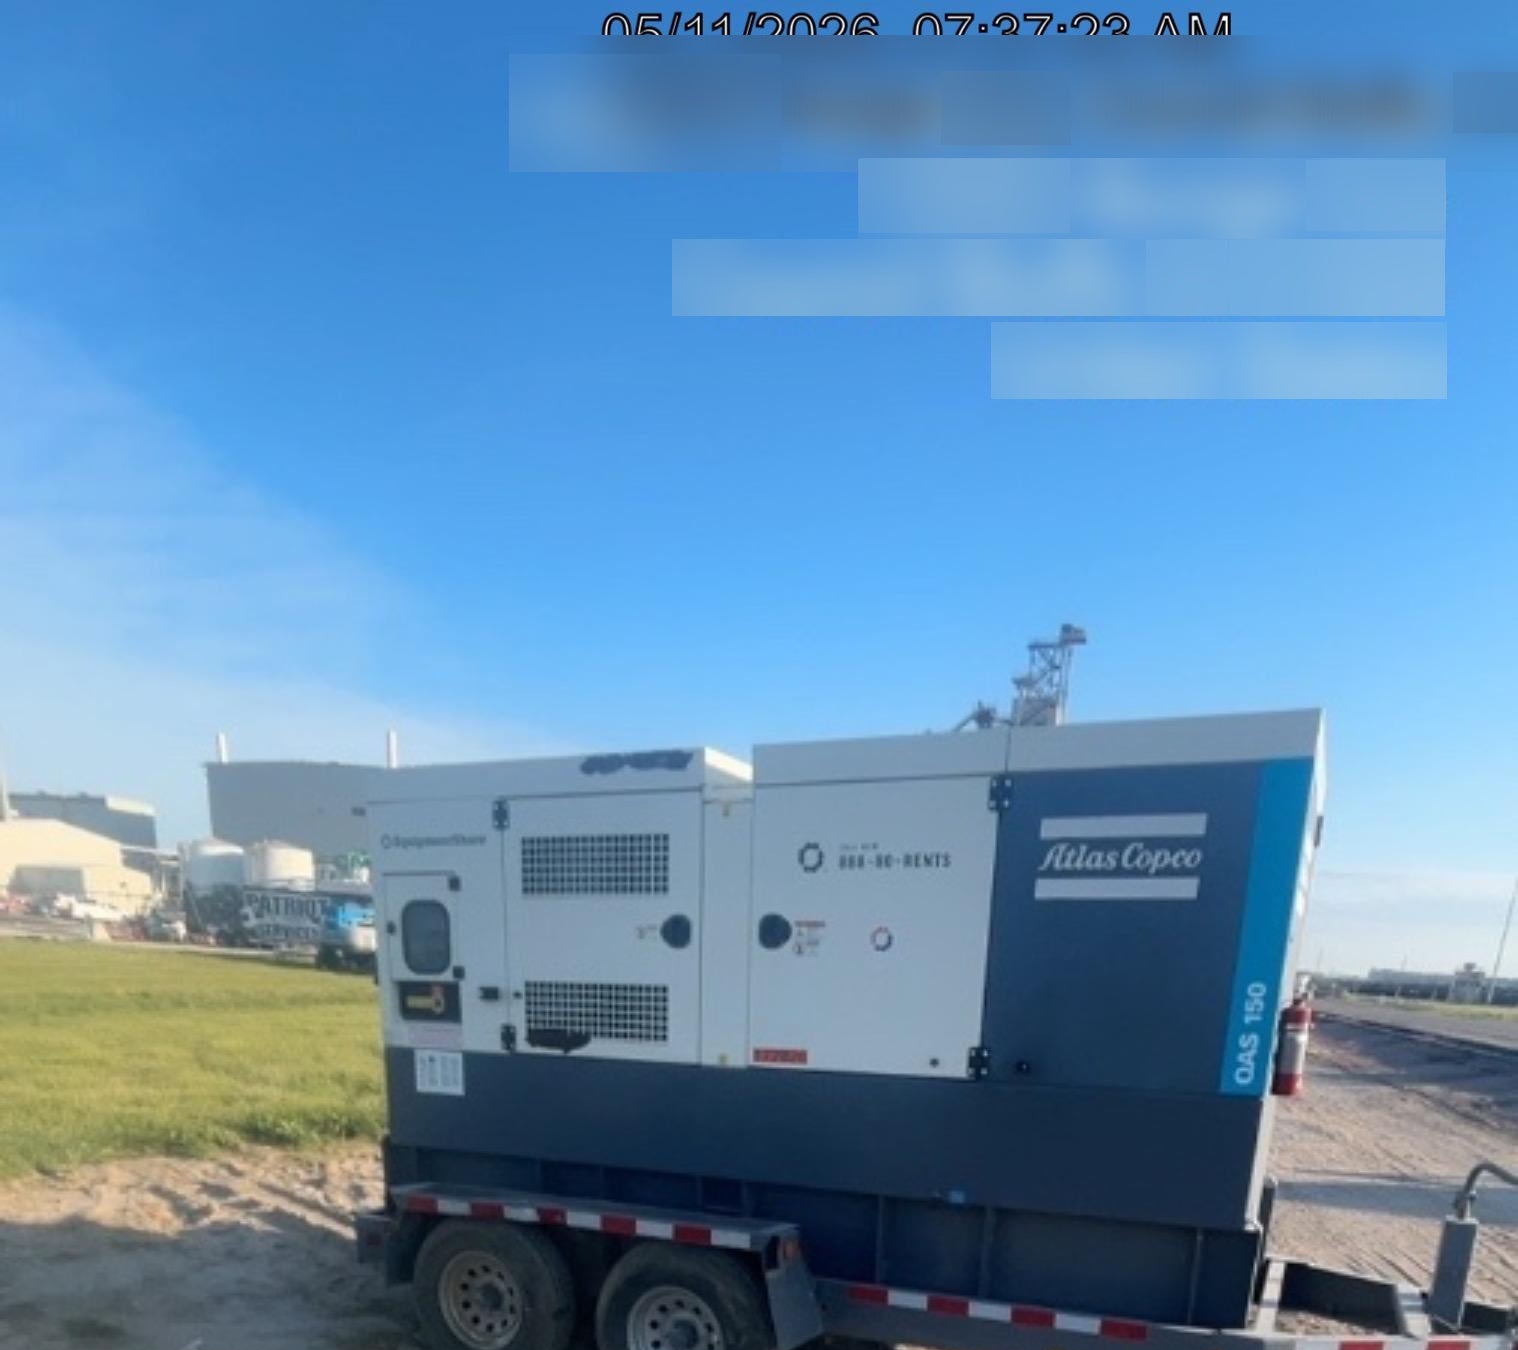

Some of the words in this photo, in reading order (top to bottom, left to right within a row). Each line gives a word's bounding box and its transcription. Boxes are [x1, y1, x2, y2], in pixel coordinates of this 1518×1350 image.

[1037, 842, 1120, 871] Atlas
[1121, 841, 1202, 874] Copco
[1244, 982, 1267, 1025] 150
